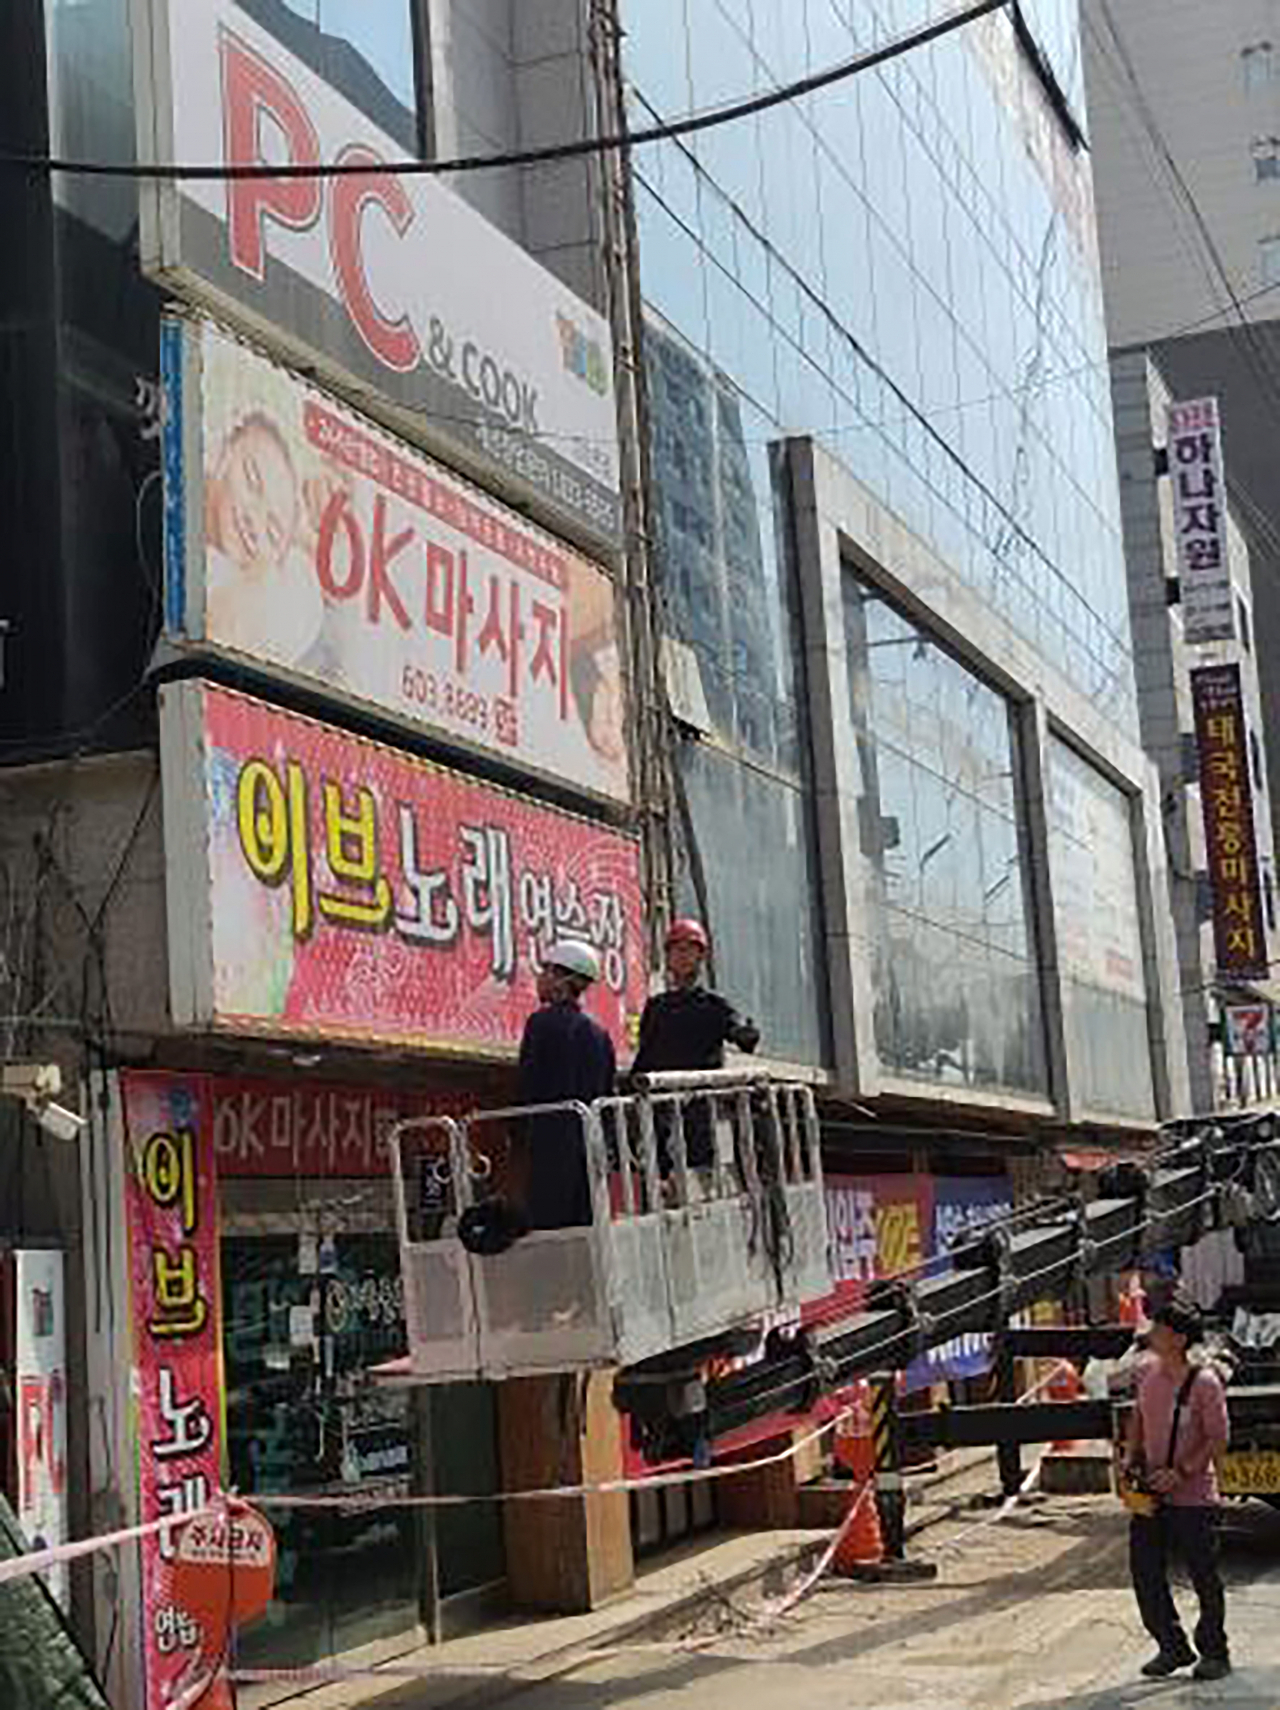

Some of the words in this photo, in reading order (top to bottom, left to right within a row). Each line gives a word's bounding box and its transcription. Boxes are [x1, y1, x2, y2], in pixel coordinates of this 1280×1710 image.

[218, 24, 416, 373] PC
[462, 341, 538, 430] COOK
[237, 757, 394, 943] 이브
[141, 1130, 207, 1338] 이브
